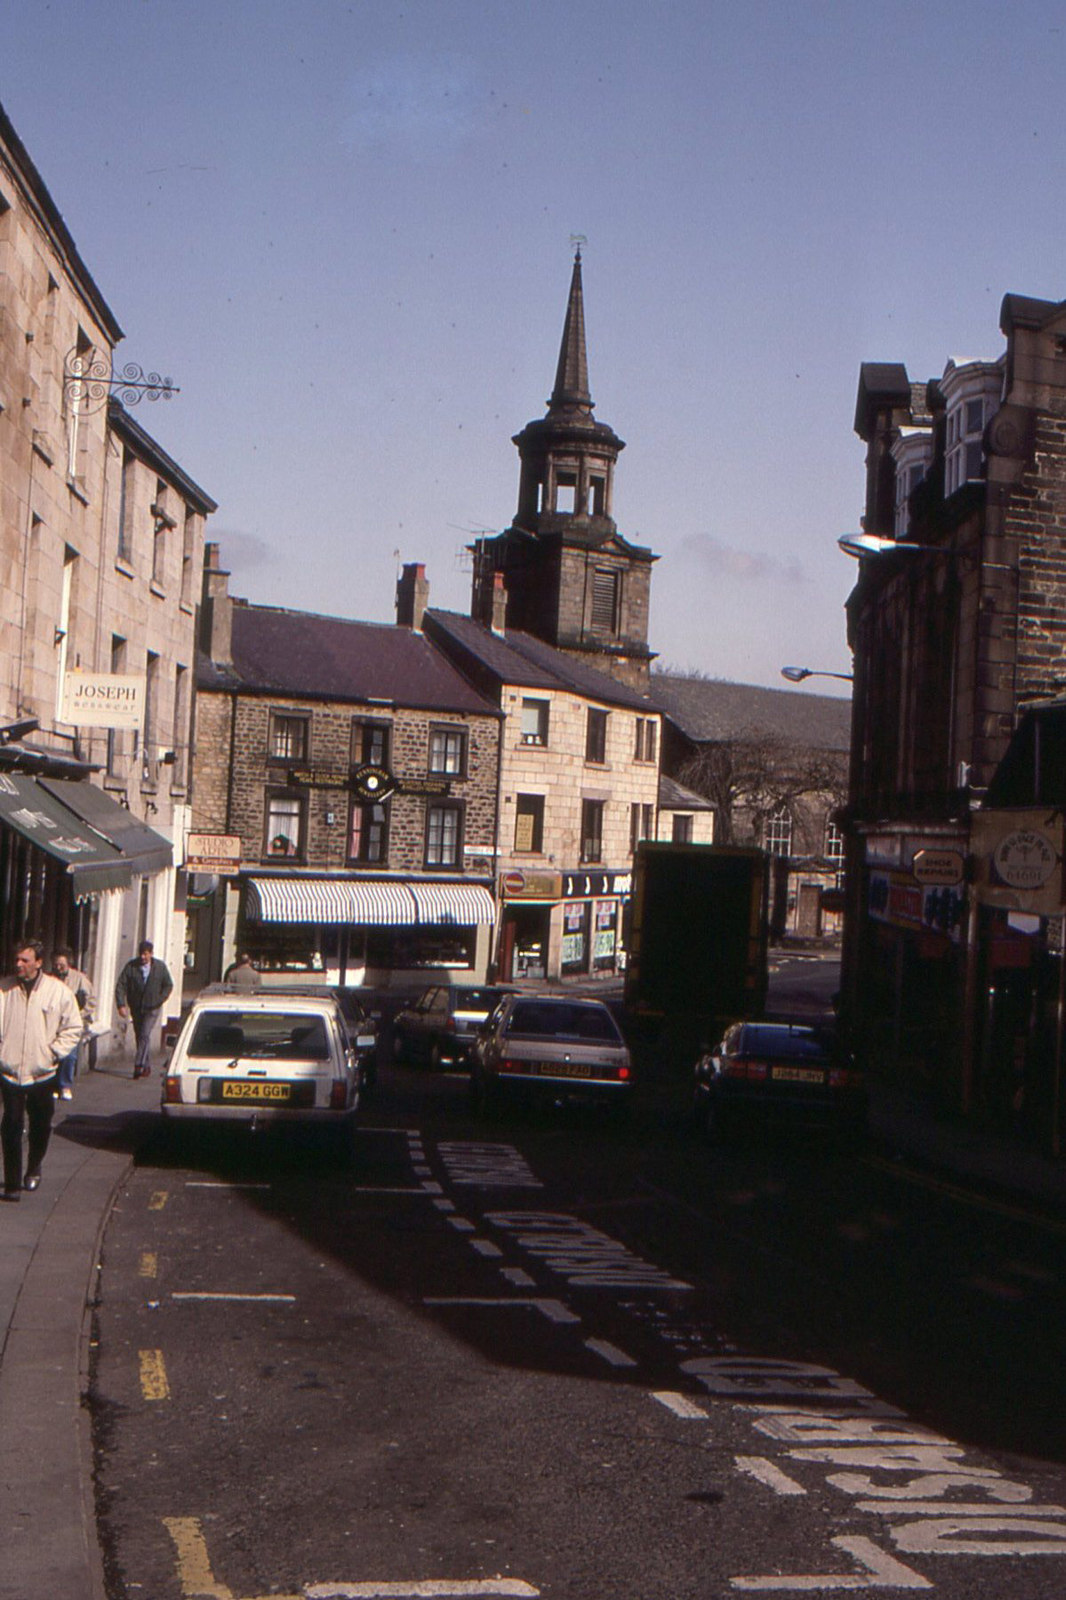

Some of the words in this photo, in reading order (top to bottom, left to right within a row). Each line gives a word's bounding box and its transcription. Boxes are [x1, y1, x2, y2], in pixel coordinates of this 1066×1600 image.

[75, 685, 136, 700] JOSEPH
[195, 837, 233, 847] STUDIO
[201, 847, 228, 855] ARTS
[226, 1083, 259, 1096] A324
[679, 1356, 1066, 1555] DISABLED
